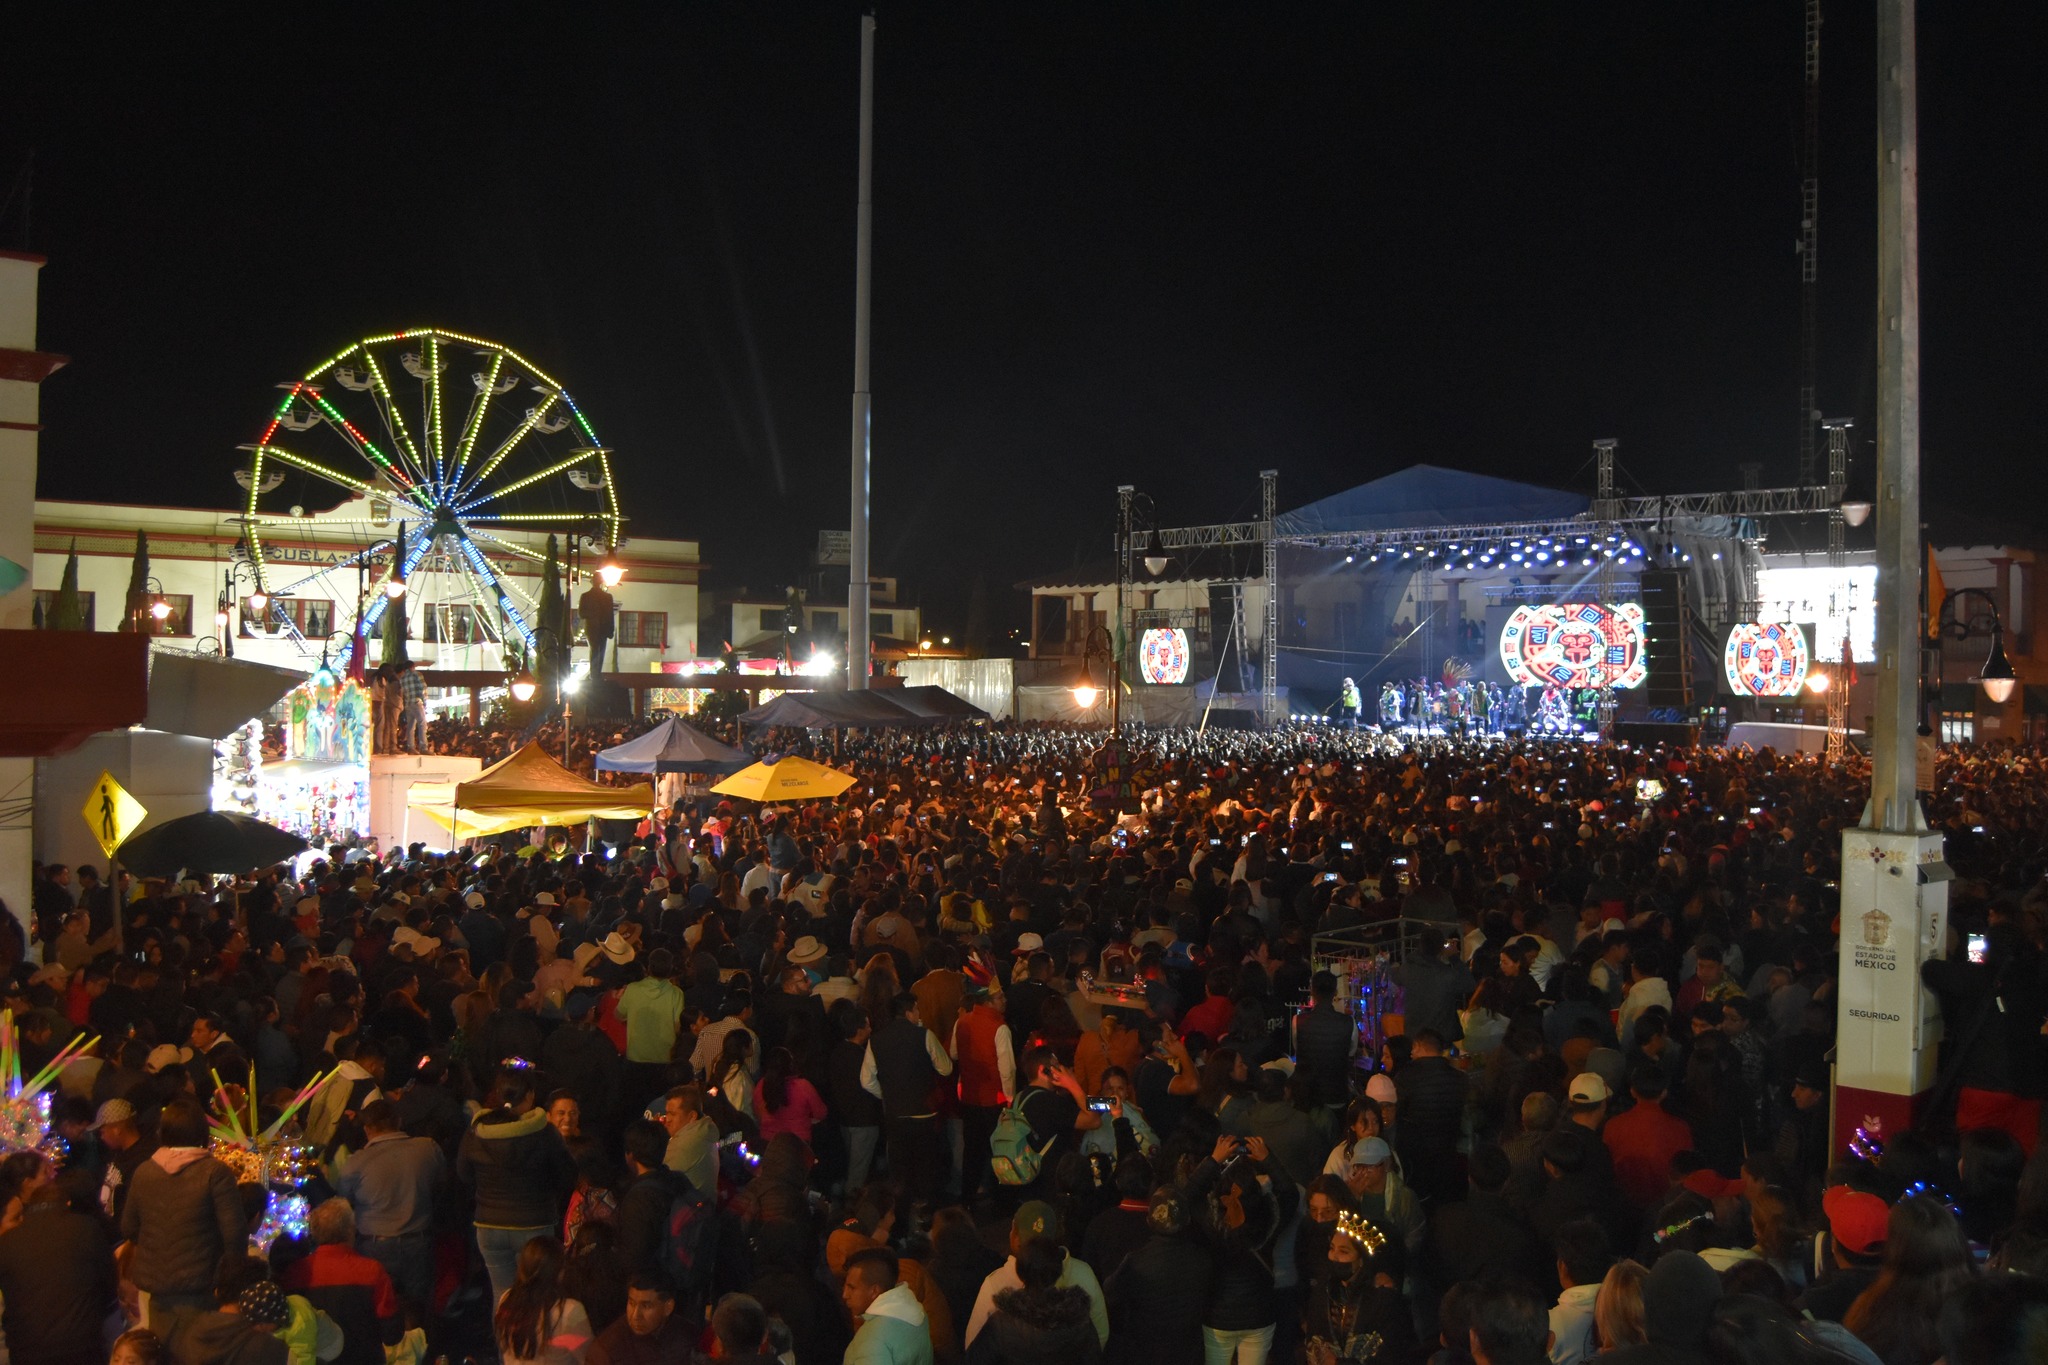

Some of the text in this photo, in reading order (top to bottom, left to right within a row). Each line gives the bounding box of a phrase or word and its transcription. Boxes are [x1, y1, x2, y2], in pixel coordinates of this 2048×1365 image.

[1855, 951, 1884, 960] ESTADO
[1855, 957, 1896, 971] MÉXICO
[1849, 1008, 1900, 1022] SEGURIDAD
